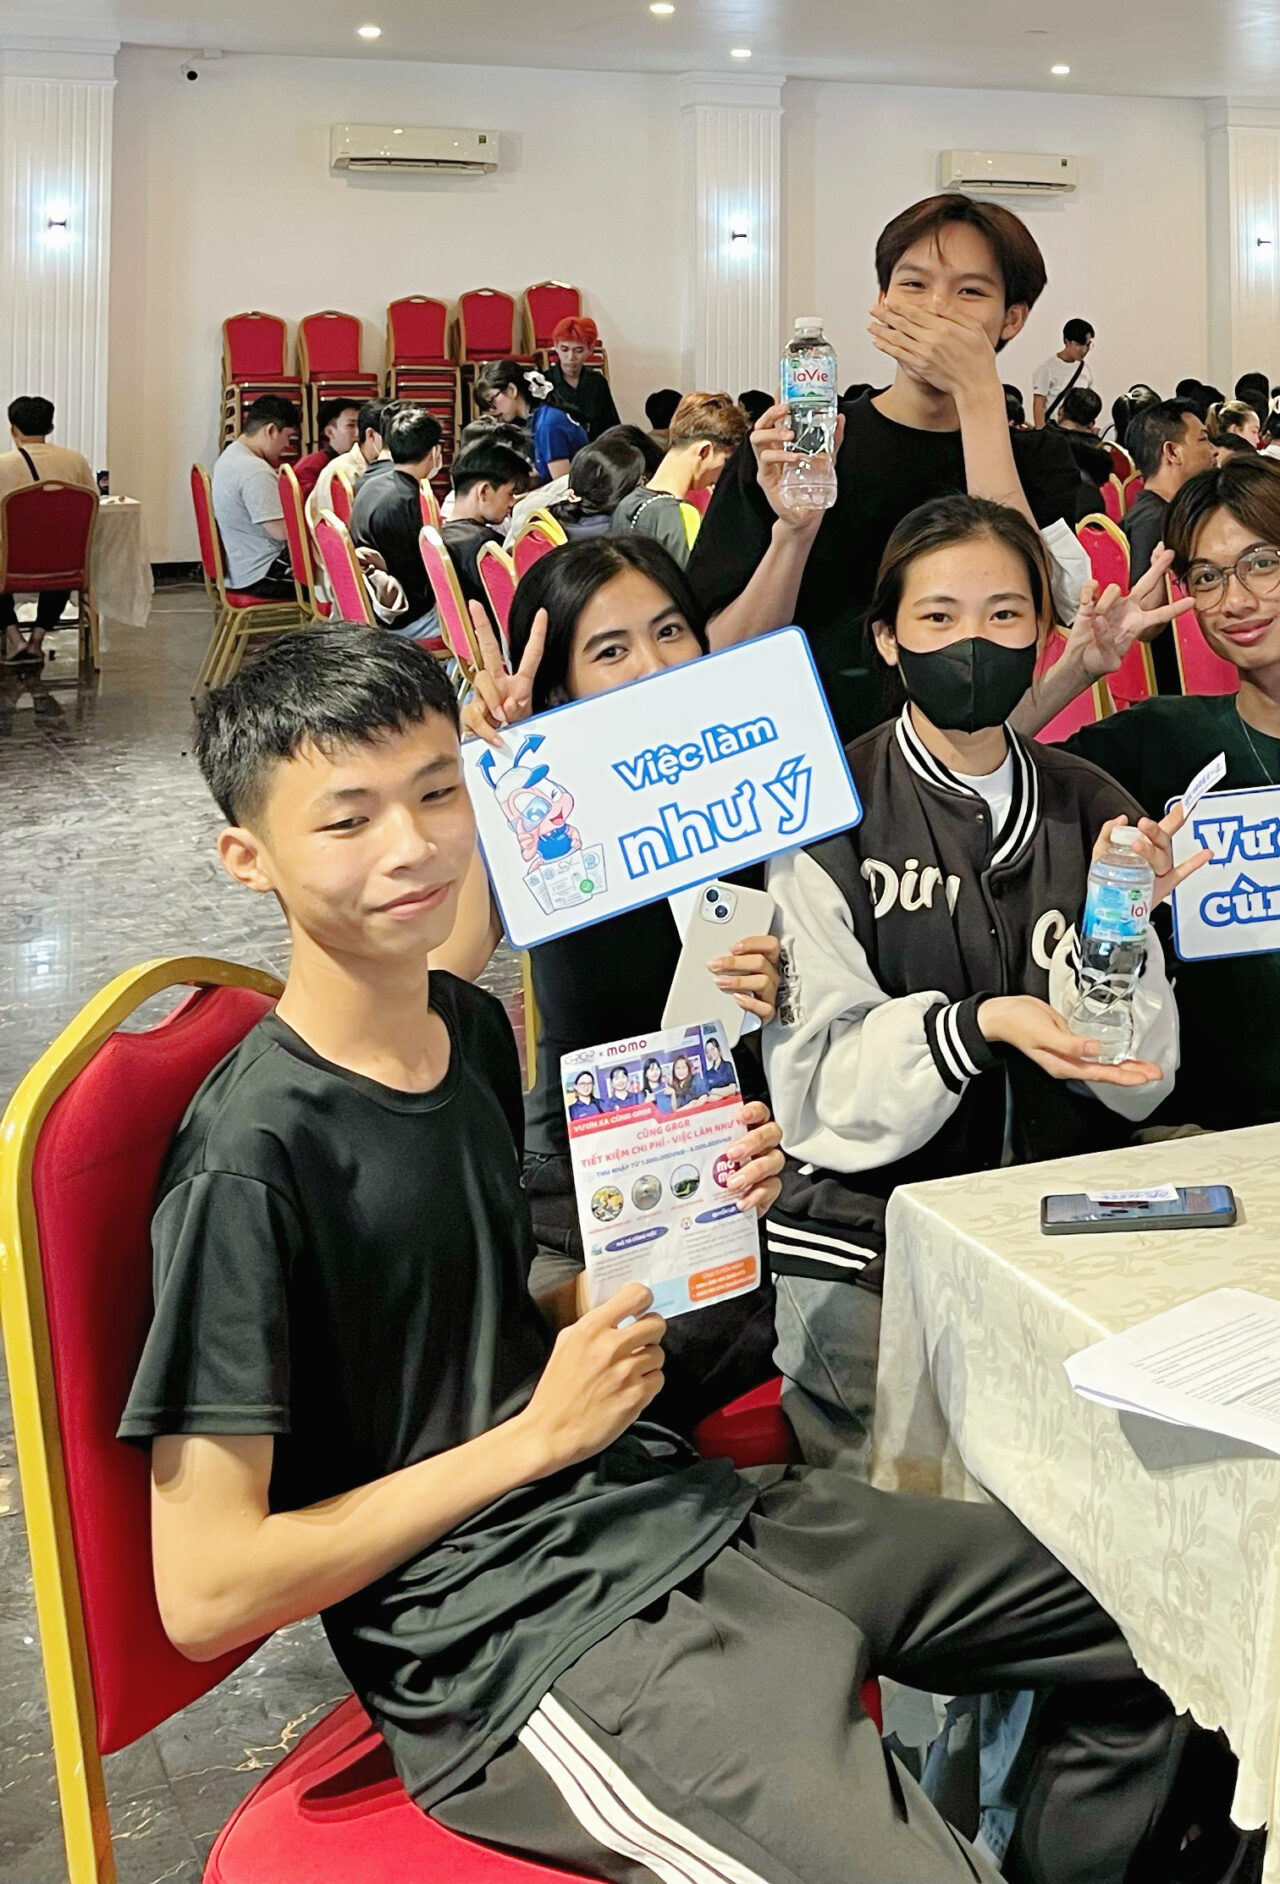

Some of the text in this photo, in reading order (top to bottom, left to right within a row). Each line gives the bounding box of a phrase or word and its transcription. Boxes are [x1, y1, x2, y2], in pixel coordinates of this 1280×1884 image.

[610, 716, 779, 792] Việc làm
[617, 753, 813, 880] như ý
[581, 1153, 603, 1168] TIẾT
[605, 1149, 631, 1164] KIỆM
[631, 1143, 647, 1156] CHI
[649, 1134, 665, 1151] PHÍ
[671, 1132, 693, 1147] VIỆC
[665, 1119, 691, 1134] GRGR
